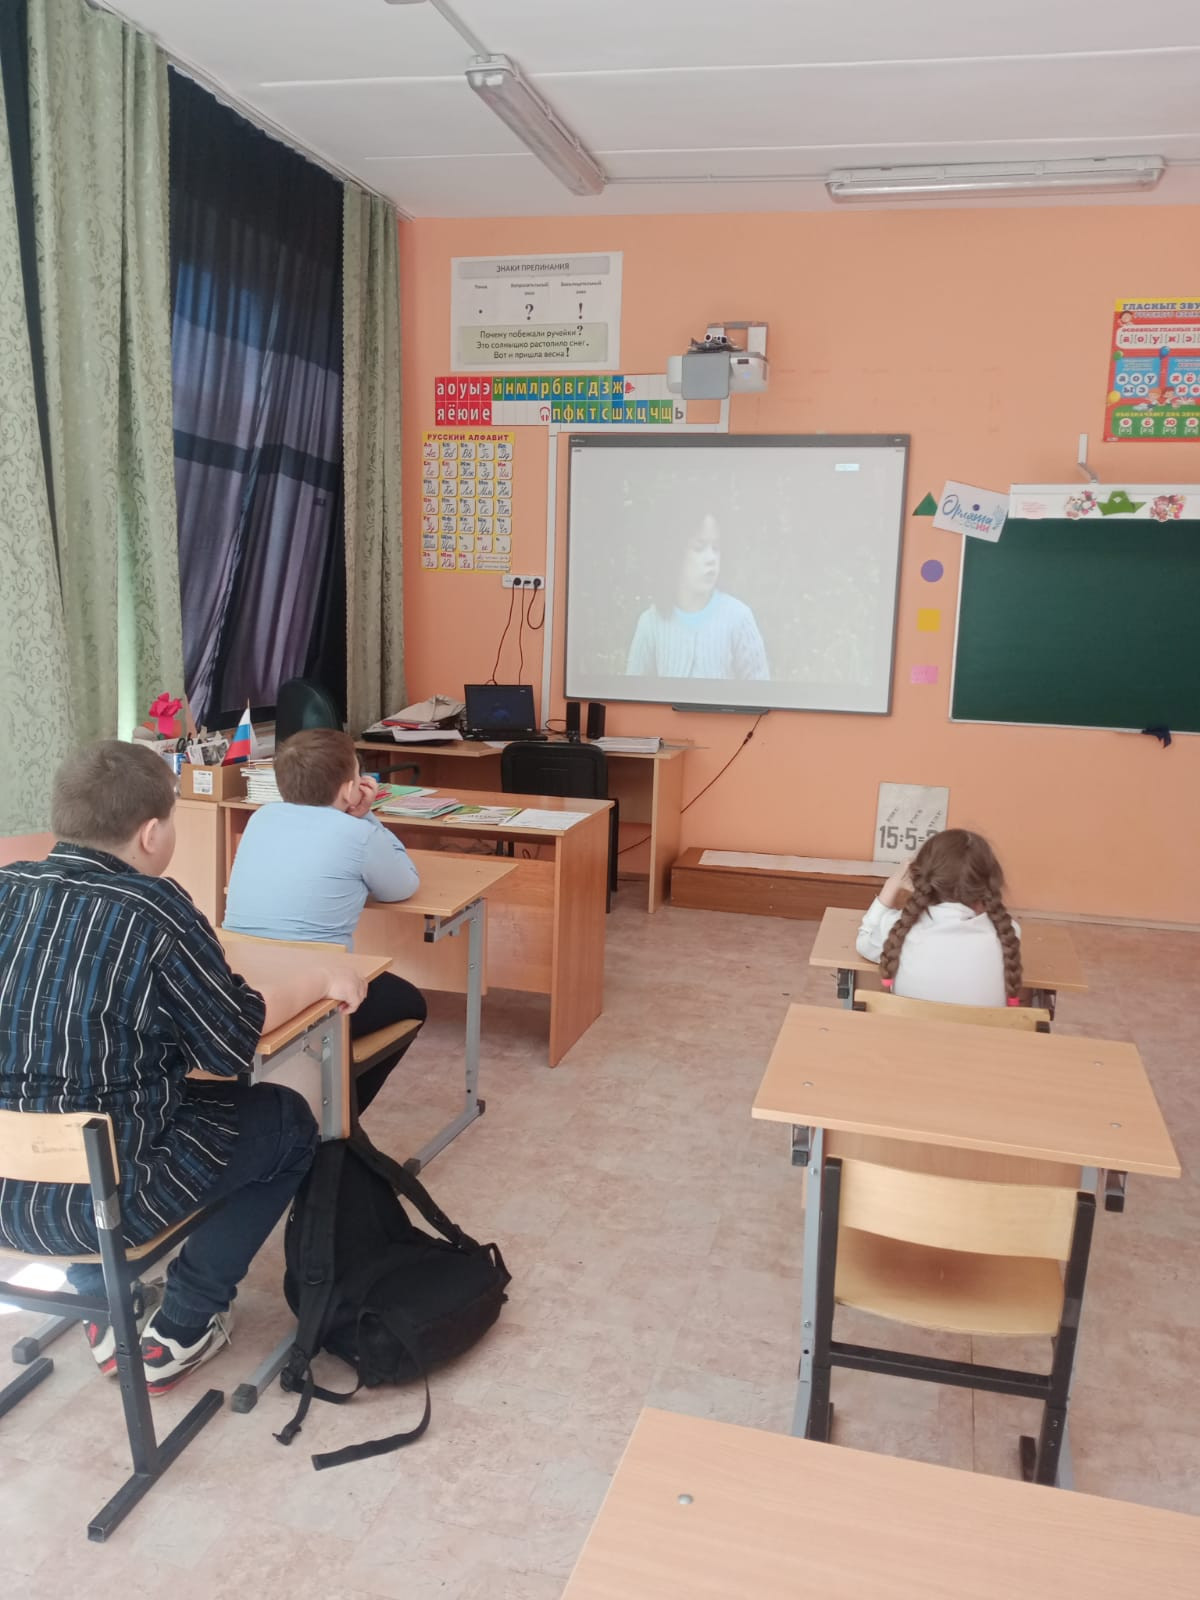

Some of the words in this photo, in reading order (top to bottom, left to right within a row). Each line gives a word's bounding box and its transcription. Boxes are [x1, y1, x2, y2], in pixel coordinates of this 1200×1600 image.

[496, 264, 520, 273] ЗНАКИ
[525, 303, 534, 320] ?
[578, 302, 583, 319] !
[1123, 303, 1177, 311] ГЛАСНЫЕ
[480, 330, 507, 340] Почему
[508, 329, 545, 338] побежали
[476, 341, 490, 349] Это
[493, 351, 507, 359] Вот
